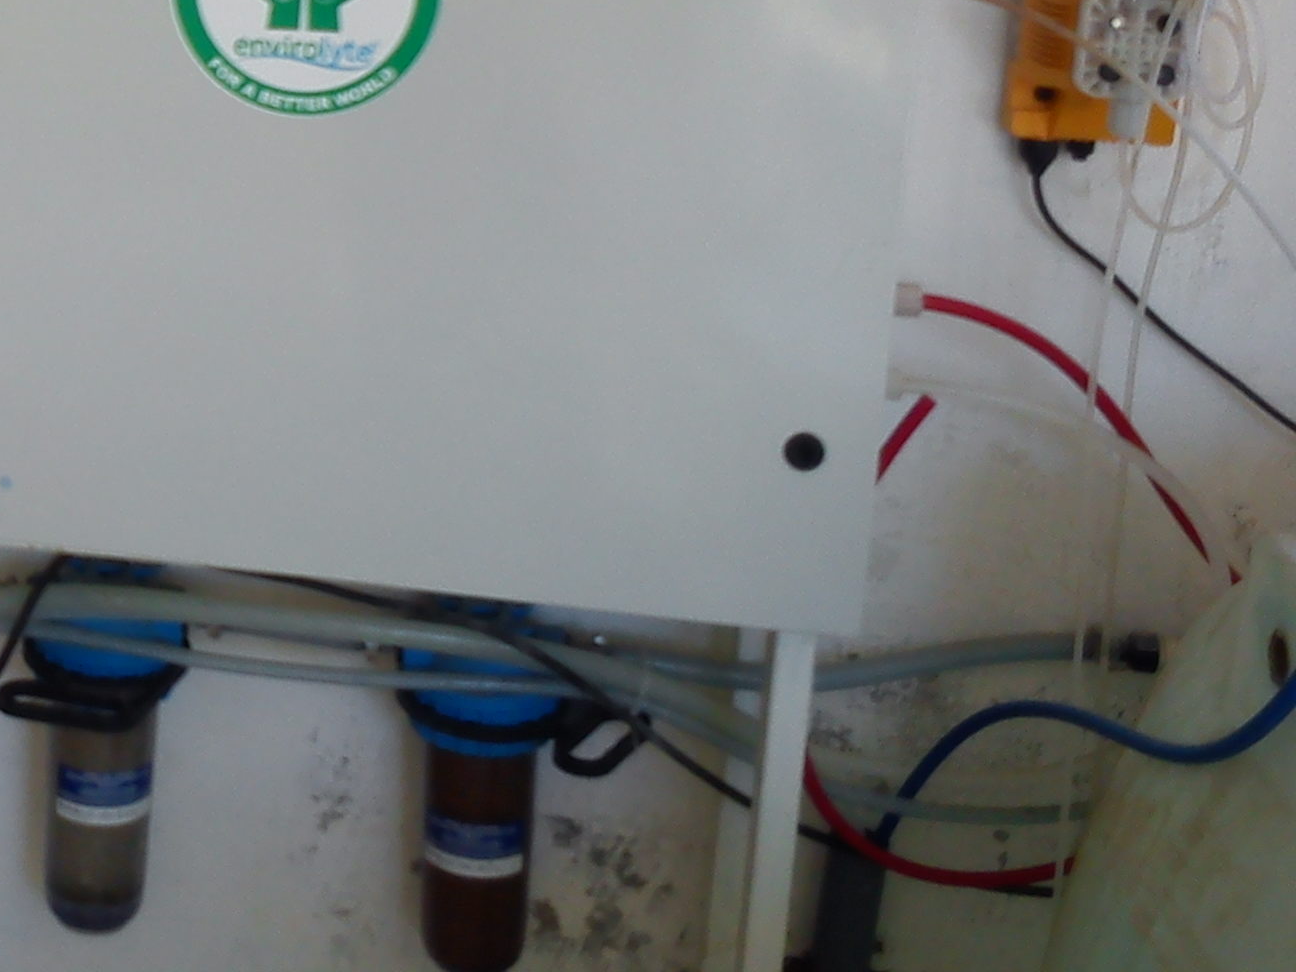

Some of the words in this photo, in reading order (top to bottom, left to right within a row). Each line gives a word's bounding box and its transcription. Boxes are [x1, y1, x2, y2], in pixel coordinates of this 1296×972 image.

[233, 36, 376, 69] envirolyte
[208, 58, 241, 90] FOR
[240, 83, 257, 99] A
[256, 89, 332, 112] BETTER
[334, 68, 395, 107] WORLD
